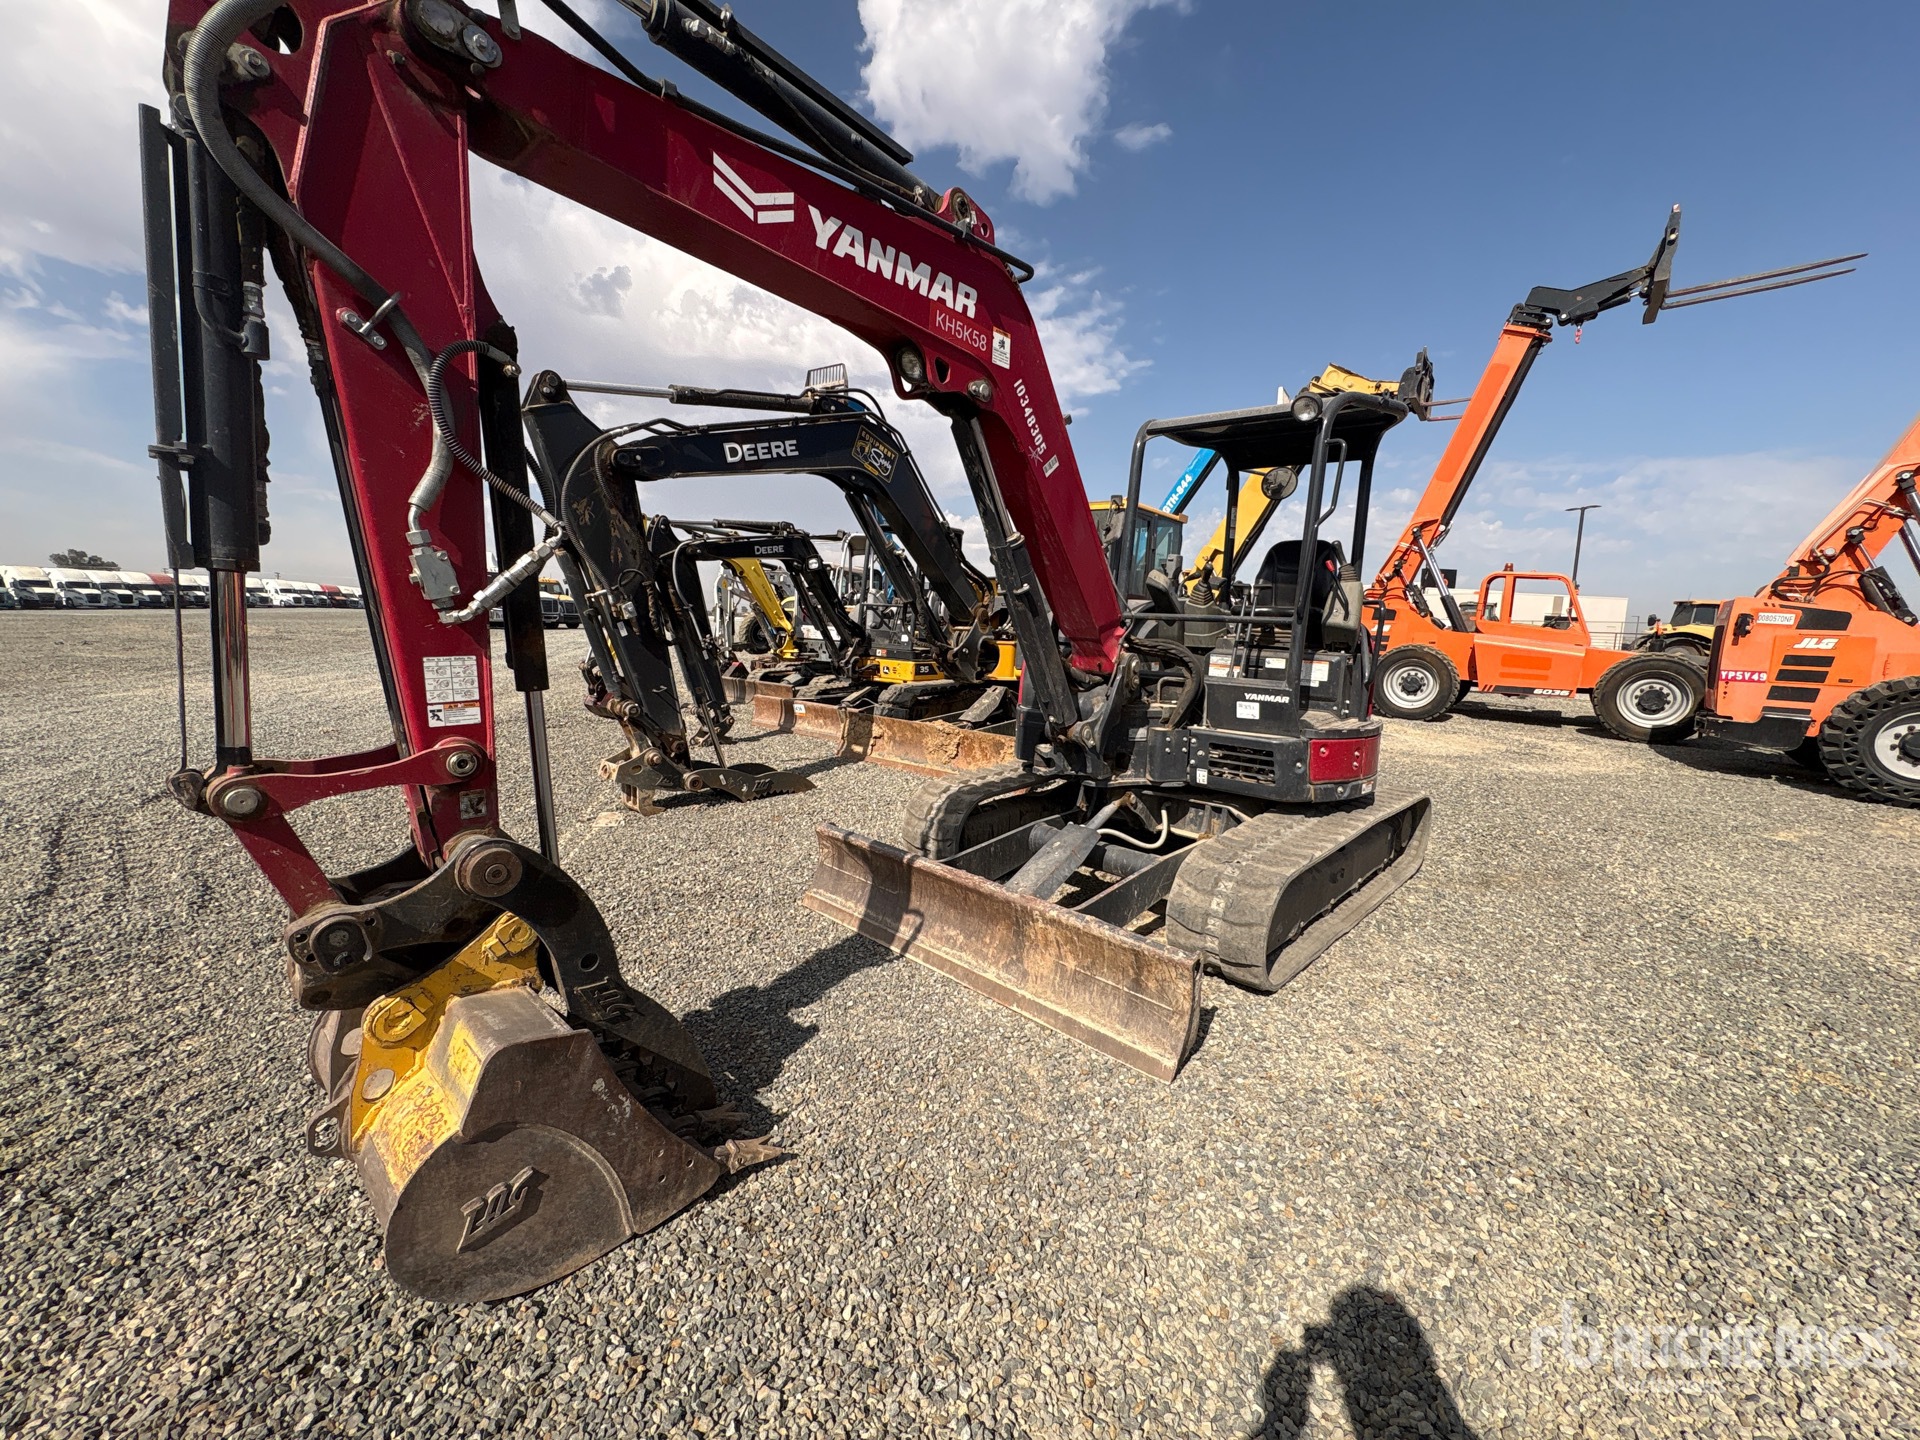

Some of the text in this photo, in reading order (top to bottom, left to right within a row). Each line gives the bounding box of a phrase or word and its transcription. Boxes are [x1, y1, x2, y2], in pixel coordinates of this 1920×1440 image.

[807, 204, 979, 319] YANMAR
[934, 309, 988, 352] KH5K58
[1013, 378, 1047, 455] 10348305
[723, 439, 799, 464] DEERE
[1162, 473, 1193, 513] GTH-844
[754, 544, 785, 555] DEERE
[1792, 637, 1840, 650] JLG
[920, 665, 929, 673] 35
[1244, 692, 1290, 704] YANMAR
